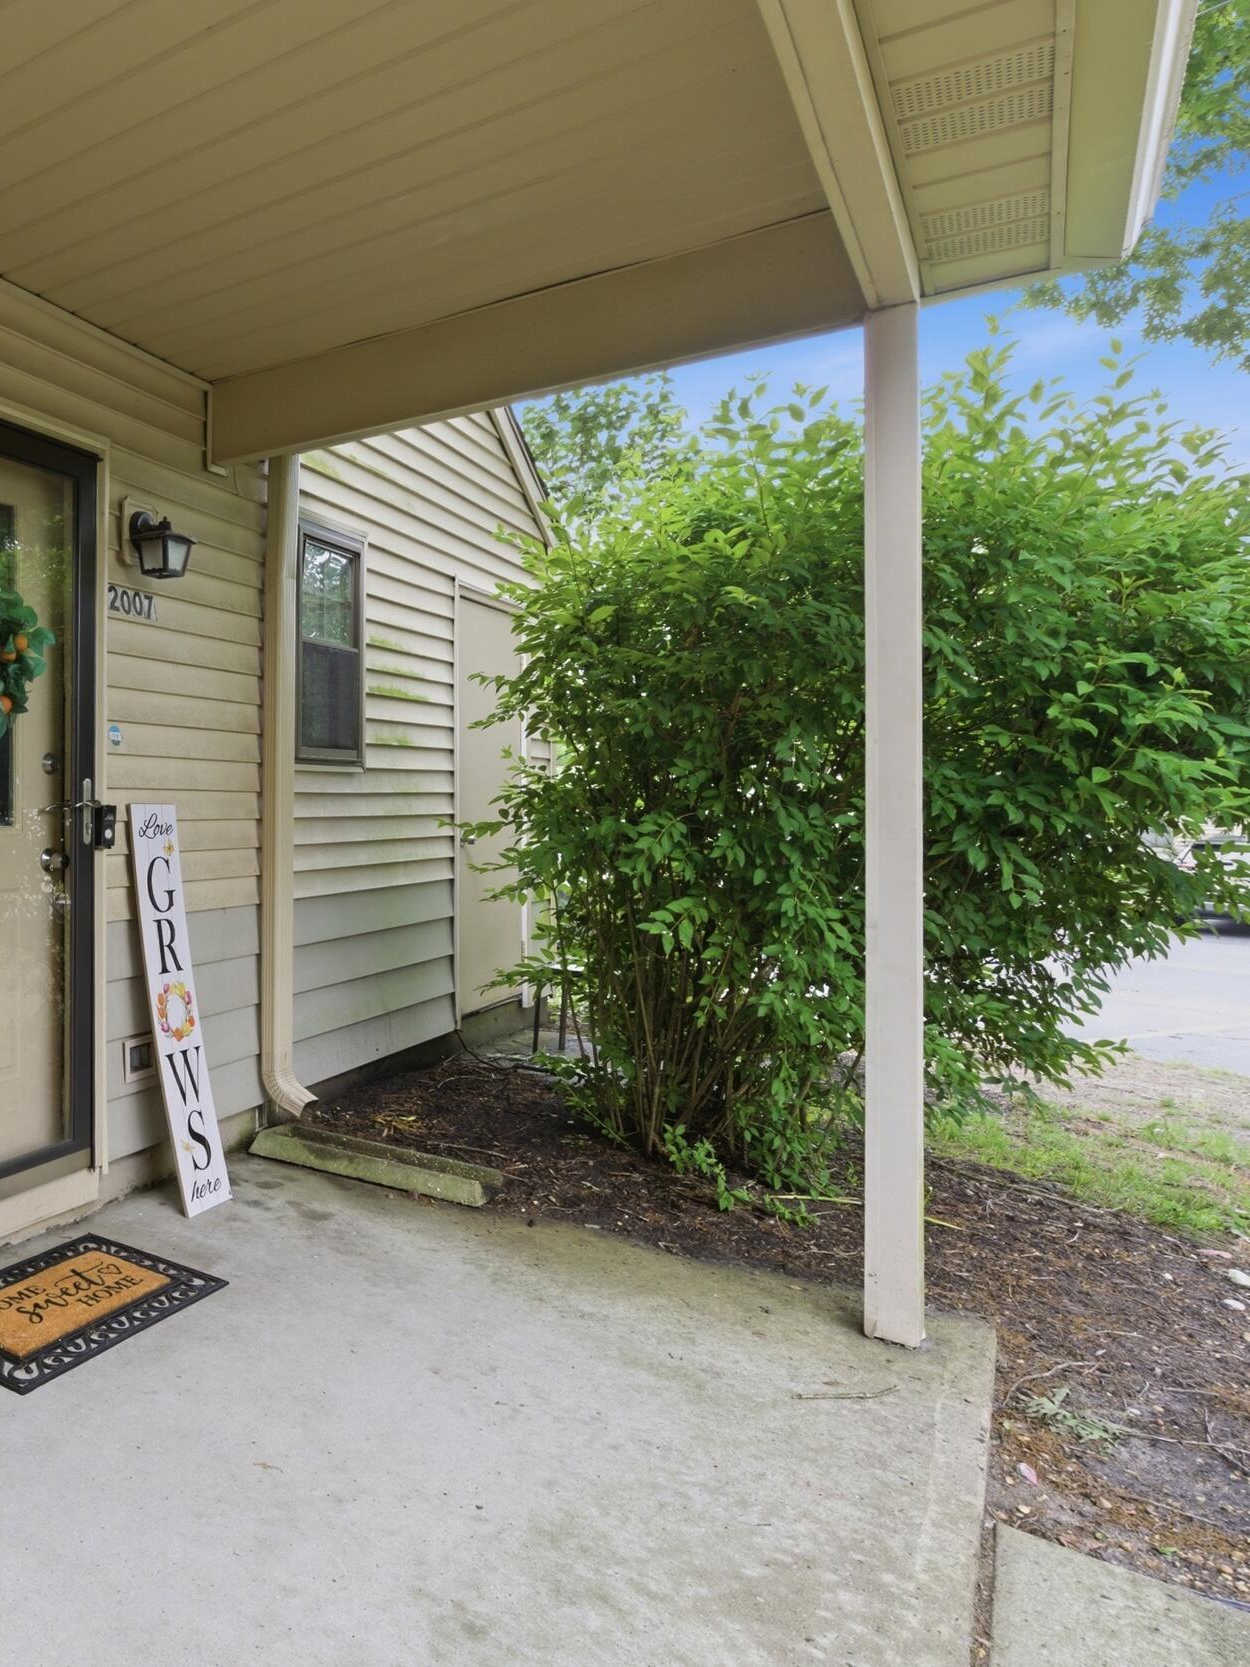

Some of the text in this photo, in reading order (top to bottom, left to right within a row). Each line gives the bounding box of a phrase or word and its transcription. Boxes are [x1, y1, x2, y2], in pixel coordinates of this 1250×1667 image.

[107, 585, 154, 620] 2007
[138, 812, 174, 840] Love
[190, 1177, 222, 1203] here
[15, 1261, 104, 1325] sweet
[75, 1274, 144, 1308] HOME
